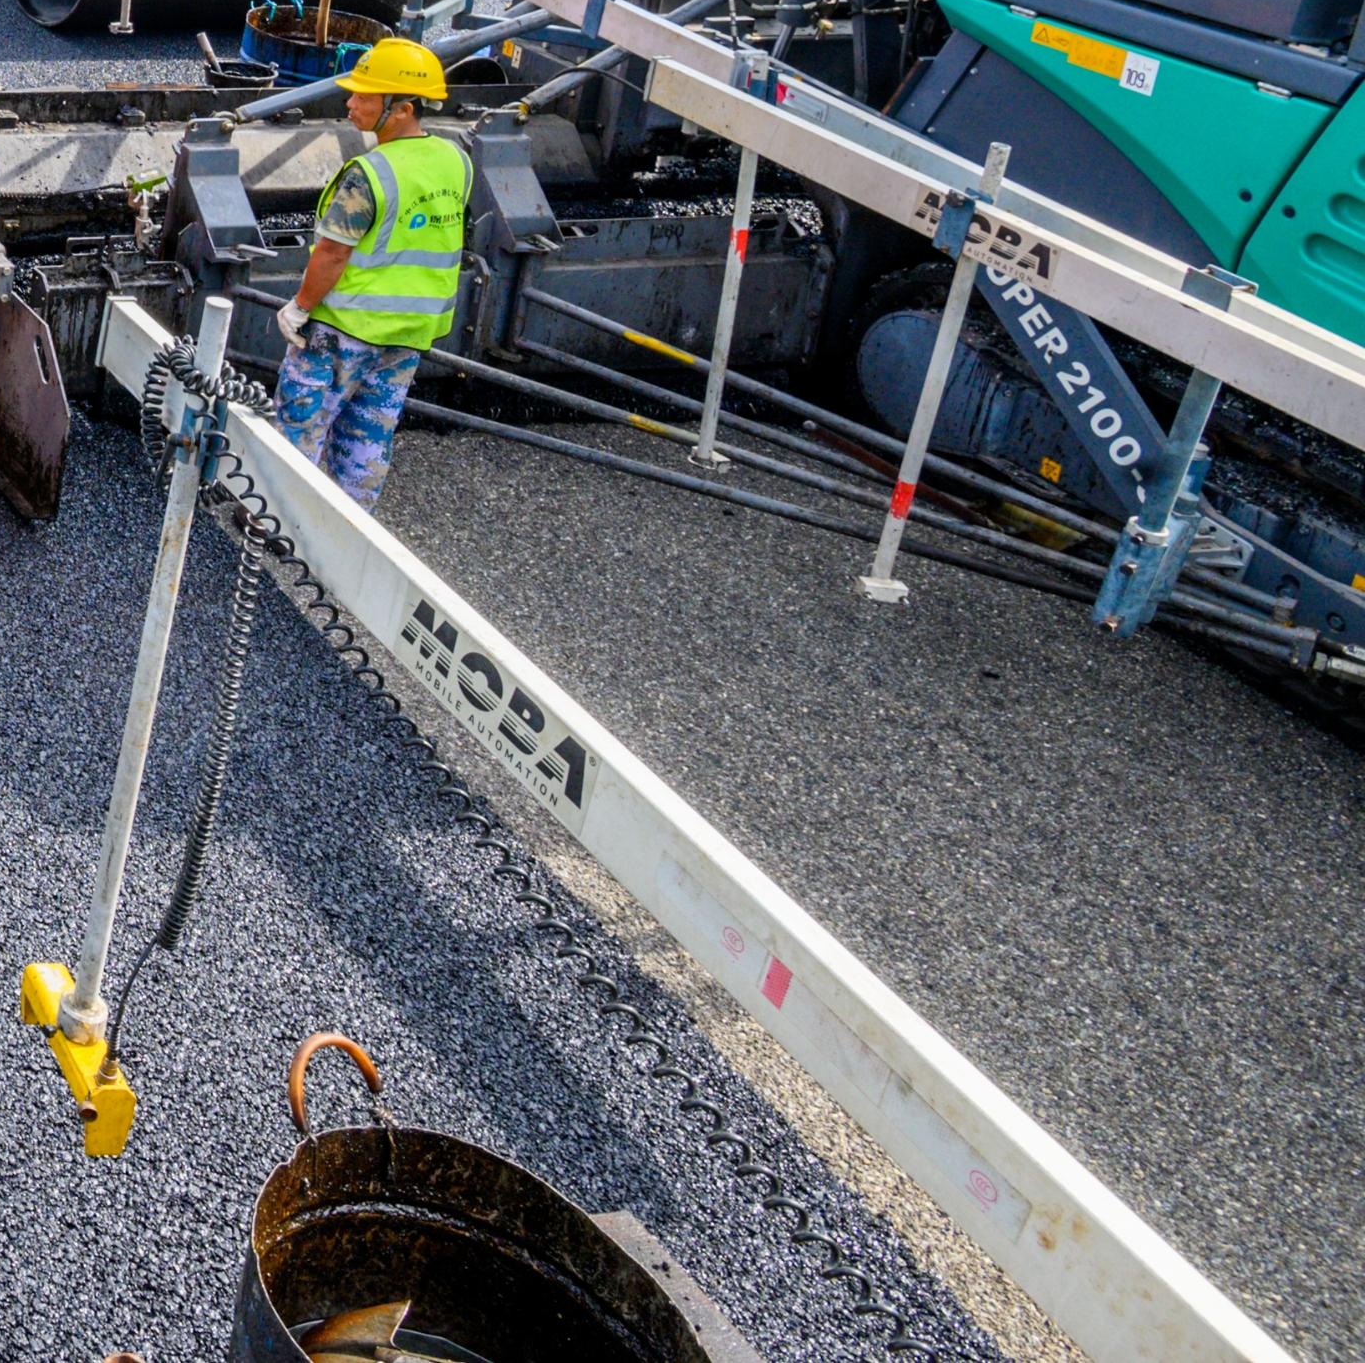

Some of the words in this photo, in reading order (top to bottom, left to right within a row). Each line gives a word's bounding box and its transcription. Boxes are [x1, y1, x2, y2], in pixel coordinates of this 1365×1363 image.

[967, 247, 1034, 283] AUTOMATION
[401, 599, 587, 810] MOBA
[415, 660, 462, 712] MOBILE
[468, 714, 559, 807] AUTOMATION
